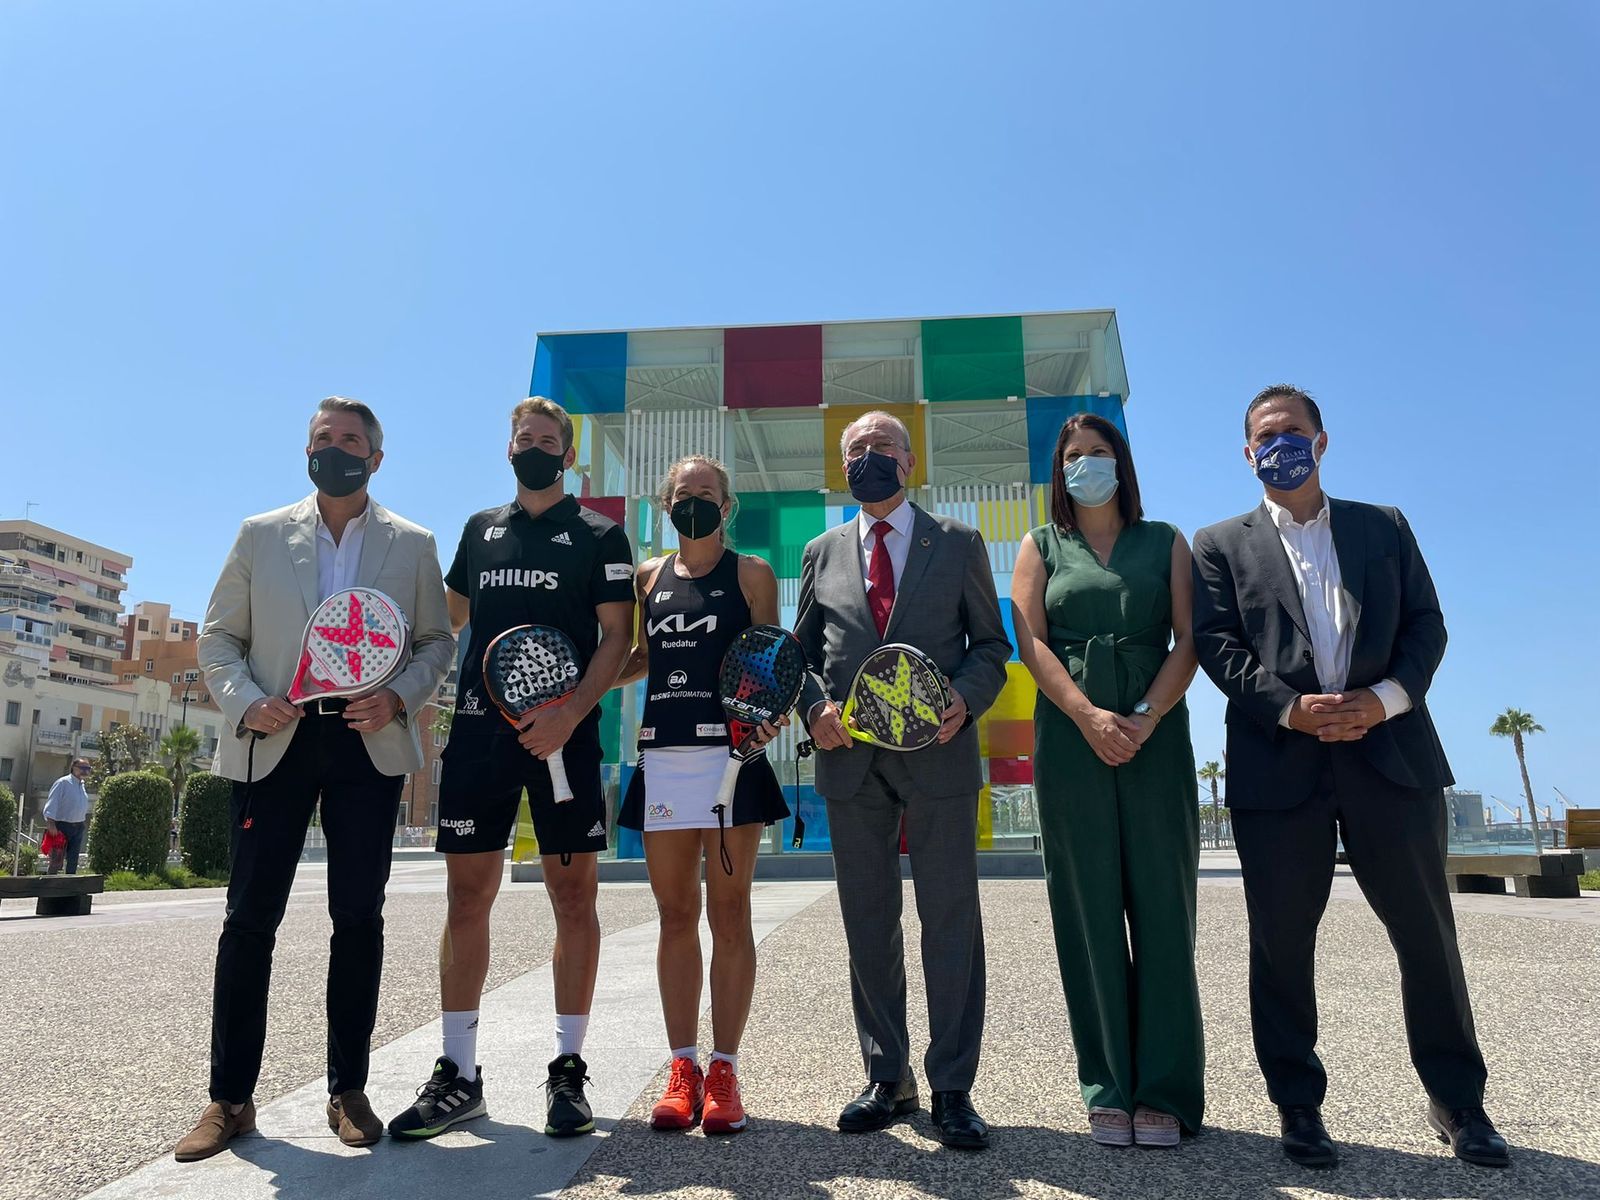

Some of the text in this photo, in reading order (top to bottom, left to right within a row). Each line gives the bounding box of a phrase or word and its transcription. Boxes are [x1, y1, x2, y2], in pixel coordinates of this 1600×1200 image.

[479, 568, 559, 590] PHILIPS
[661, 640, 697, 649] Ruedatur
[504, 662, 578, 703] adidas
[923, 670, 940, 696] nox
[721, 696, 772, 718] starvie
[440, 819, 474, 828] GLUCO
[456, 827, 475, 836] UP!
